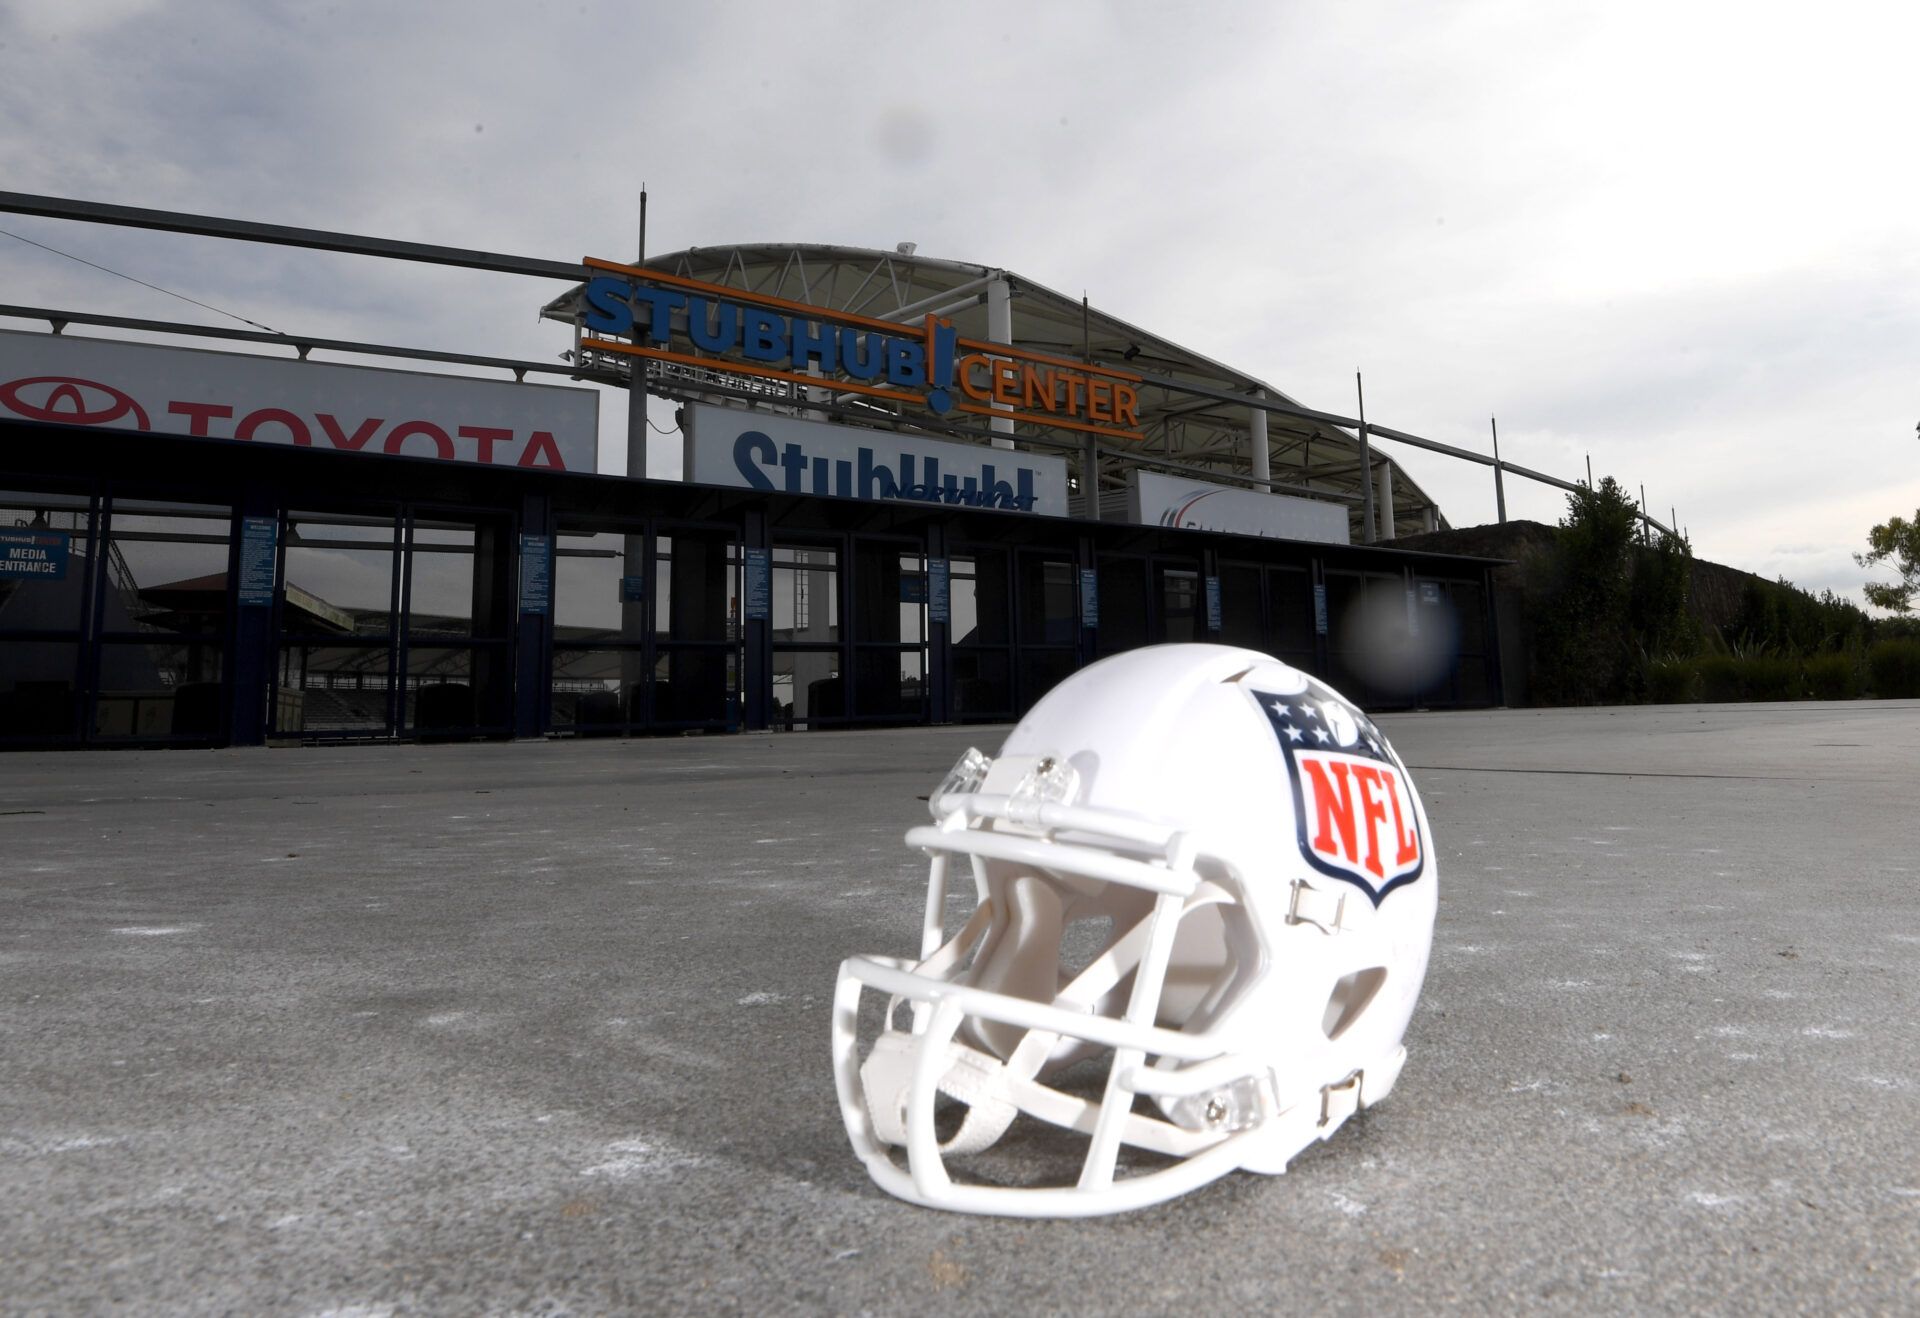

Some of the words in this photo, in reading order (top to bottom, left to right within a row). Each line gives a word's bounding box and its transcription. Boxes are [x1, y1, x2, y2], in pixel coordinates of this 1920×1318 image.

[584, 277, 957, 415] STUBHUB!
[957, 353, 1139, 427] CENTER
[167, 400, 567, 471] TOYOTA
[0, 535, 36, 545] TUBHUB!
[9, 548, 47, 560] MEDIA
[0, 560, 57, 574] ENTRANCE
[1302, 758, 1418, 879] NFL
